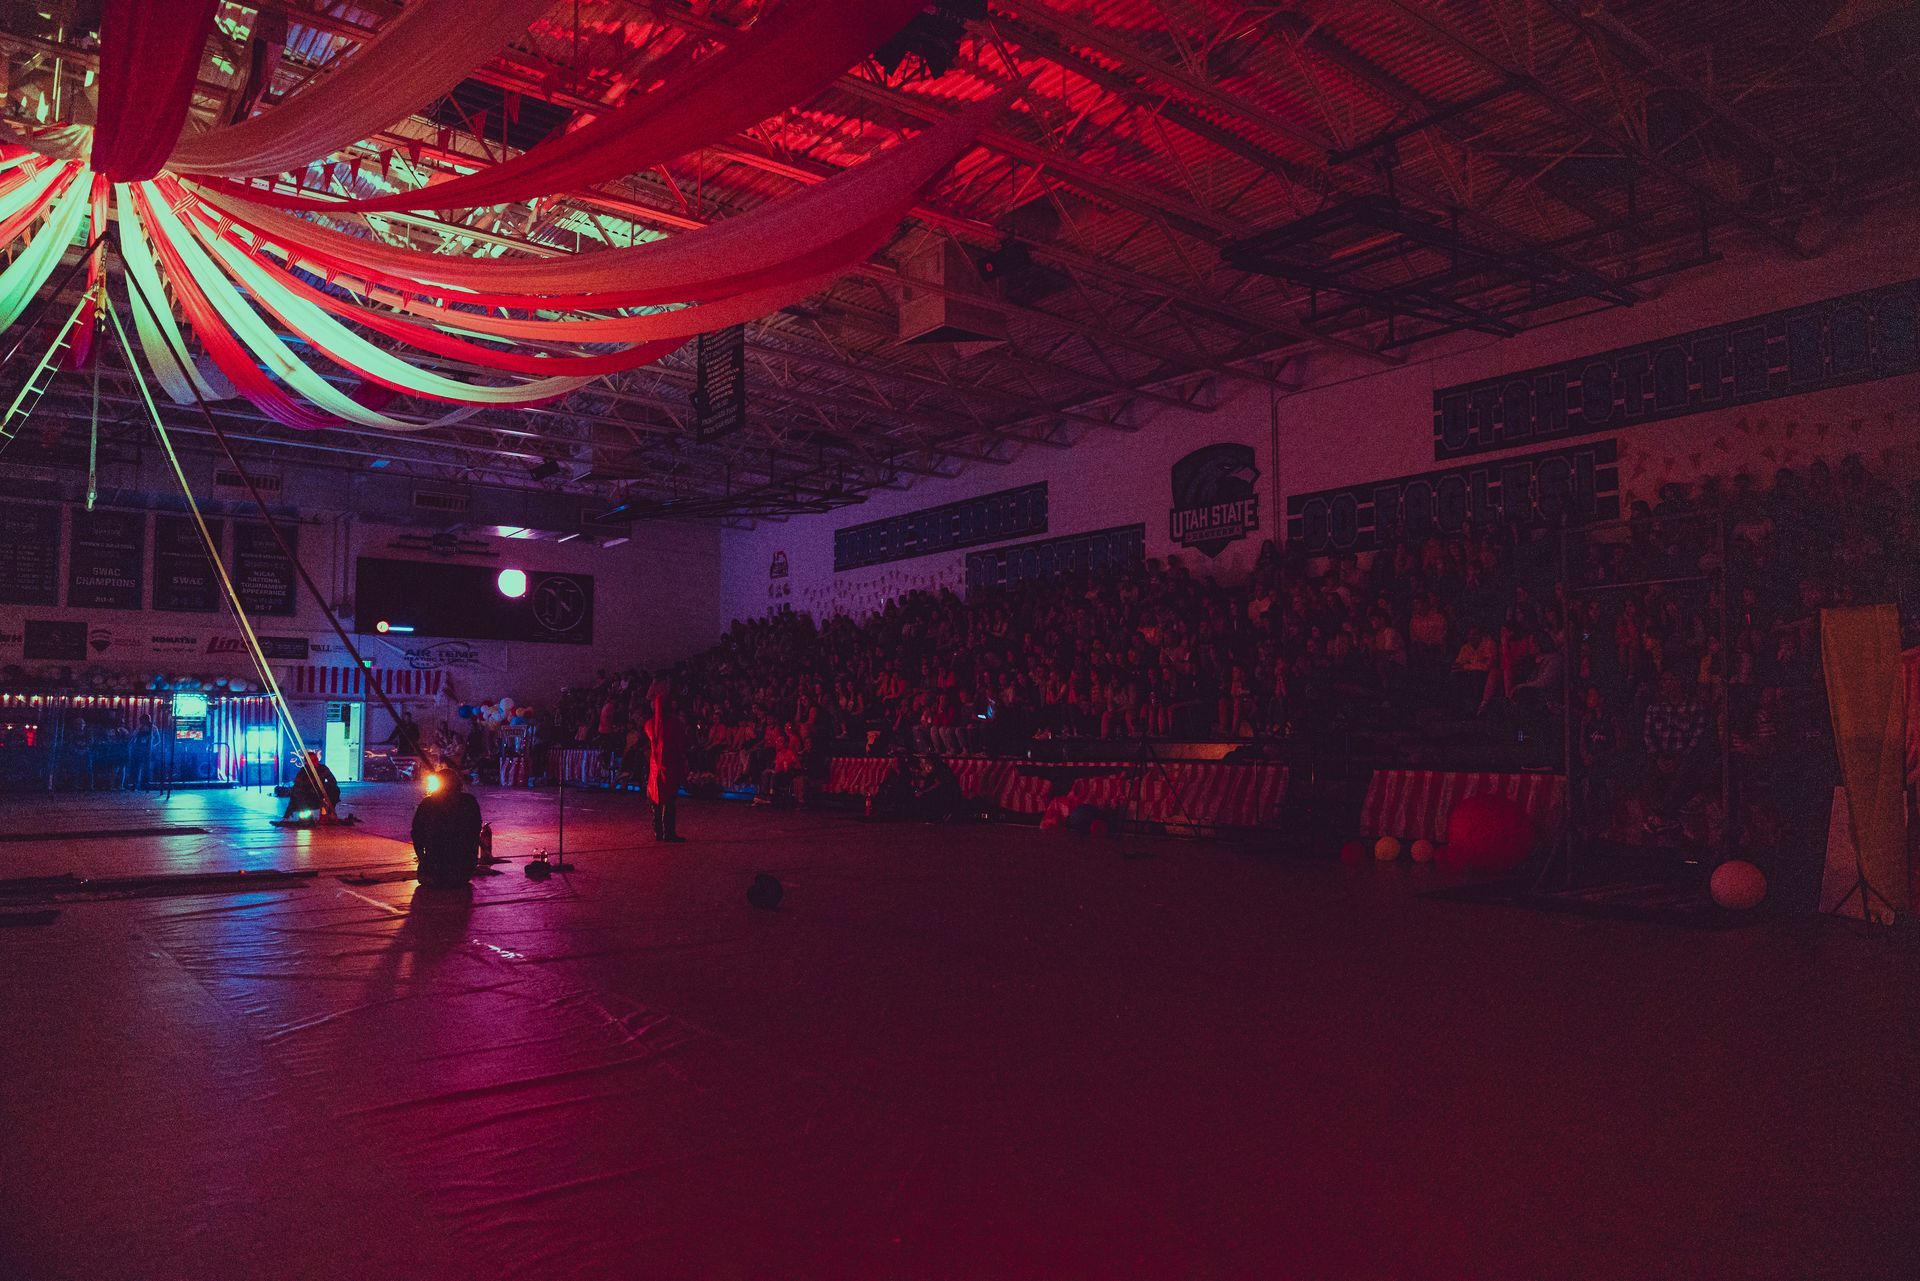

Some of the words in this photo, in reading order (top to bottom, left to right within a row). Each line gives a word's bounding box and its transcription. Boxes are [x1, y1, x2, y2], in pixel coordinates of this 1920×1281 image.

[1441, 370, 1570, 451] UTAH
[1580, 325, 1770, 423] STATE
[1172, 507, 1208, 538] UTAH
[1211, 498, 1256, 528] STATE
[1301, 491, 1359, 553] GO
[92, 566, 121, 577] SWAC
[75, 576, 136, 588] CHAMPIONS
[172, 576, 204, 586] SWAC
[151, 636, 197, 644] KOMATSU
[405, 649, 432, 657] AIR
[438, 650, 479, 658] TEMP
